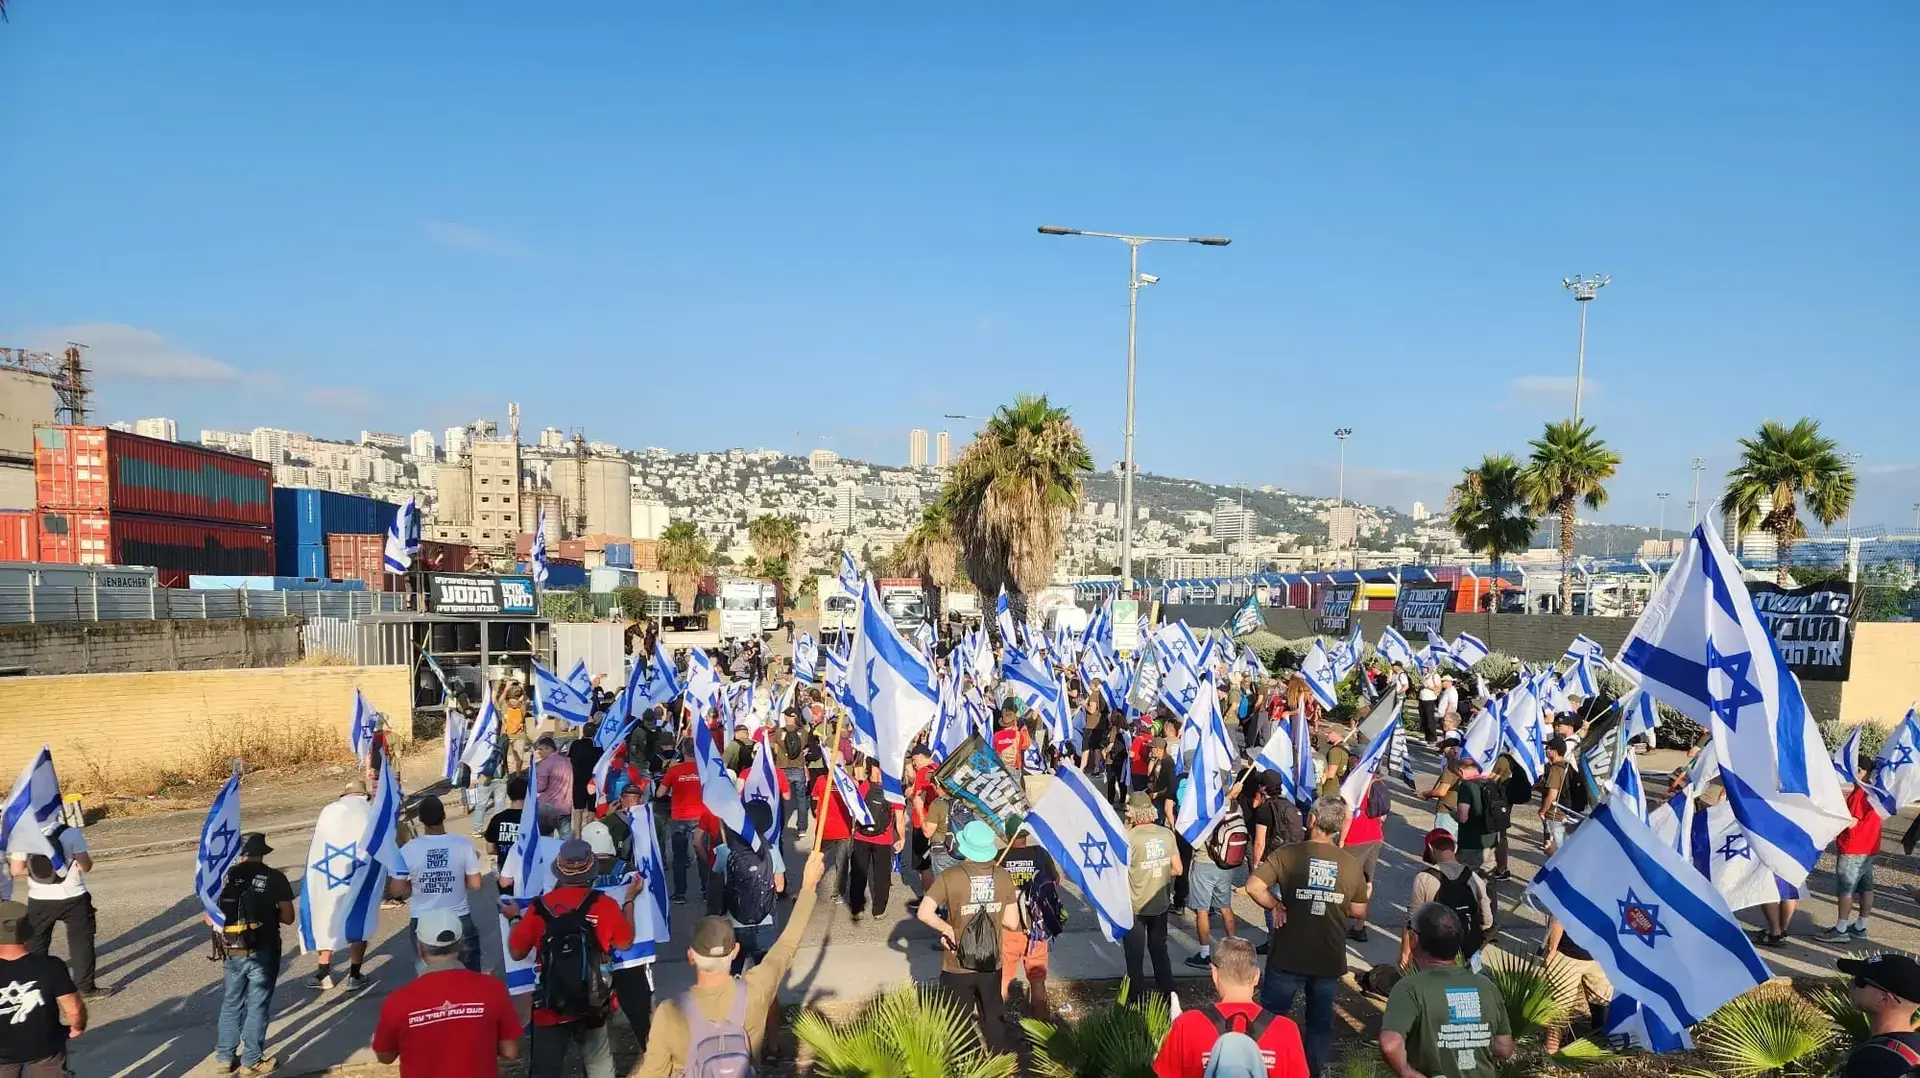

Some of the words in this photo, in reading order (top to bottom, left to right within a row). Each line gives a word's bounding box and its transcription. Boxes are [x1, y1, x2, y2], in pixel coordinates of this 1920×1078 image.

[440, 585, 495, 603] המסע
[503, 594, 533, 608] לנשק
[1764, 616, 1841, 641] מטביע
[1812, 641, 1843, 666] את
[427, 860, 448, 869] לנשק
[425, 1011, 446, 1020] תמיד
